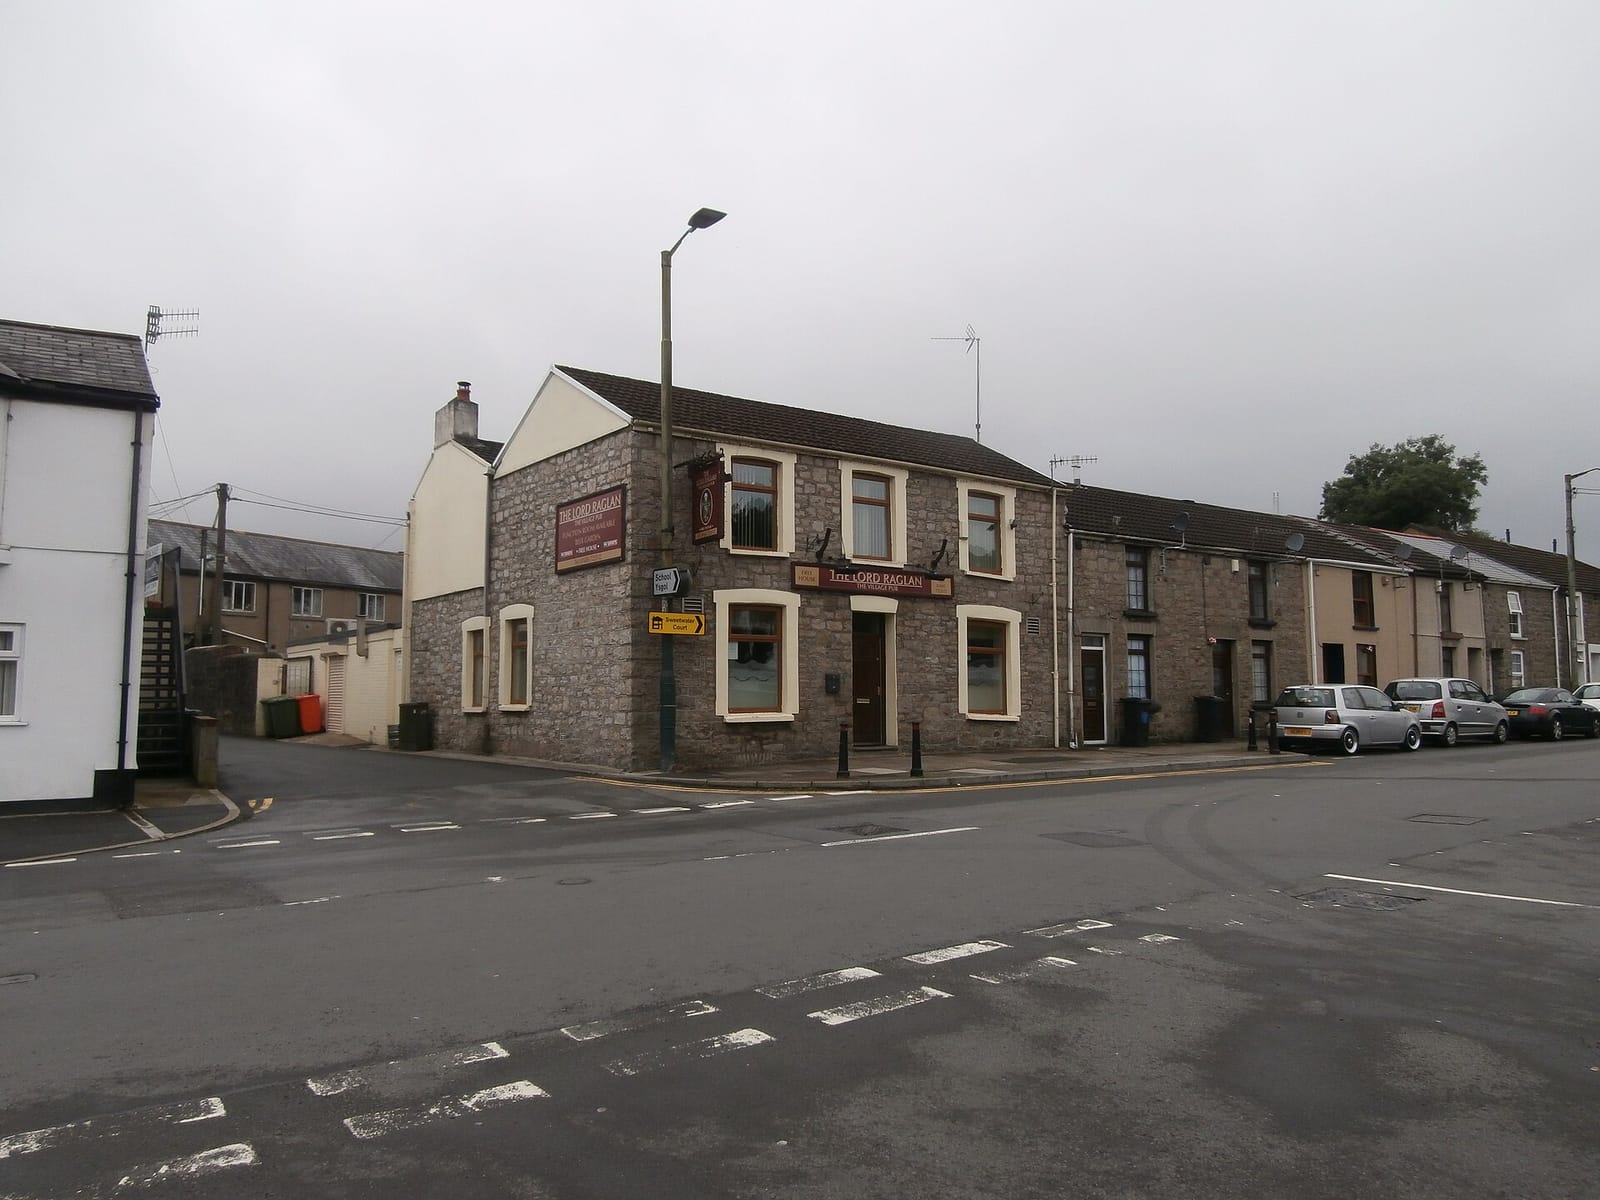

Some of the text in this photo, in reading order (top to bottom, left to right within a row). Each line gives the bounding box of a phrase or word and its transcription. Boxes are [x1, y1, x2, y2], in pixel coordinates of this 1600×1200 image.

[559, 494, 621, 523] THE LORD RAGLAN
[655, 572, 672, 582] School
[798, 575, 816, 583] HOUSE
[883, 574, 922, 586] RAGLAN
